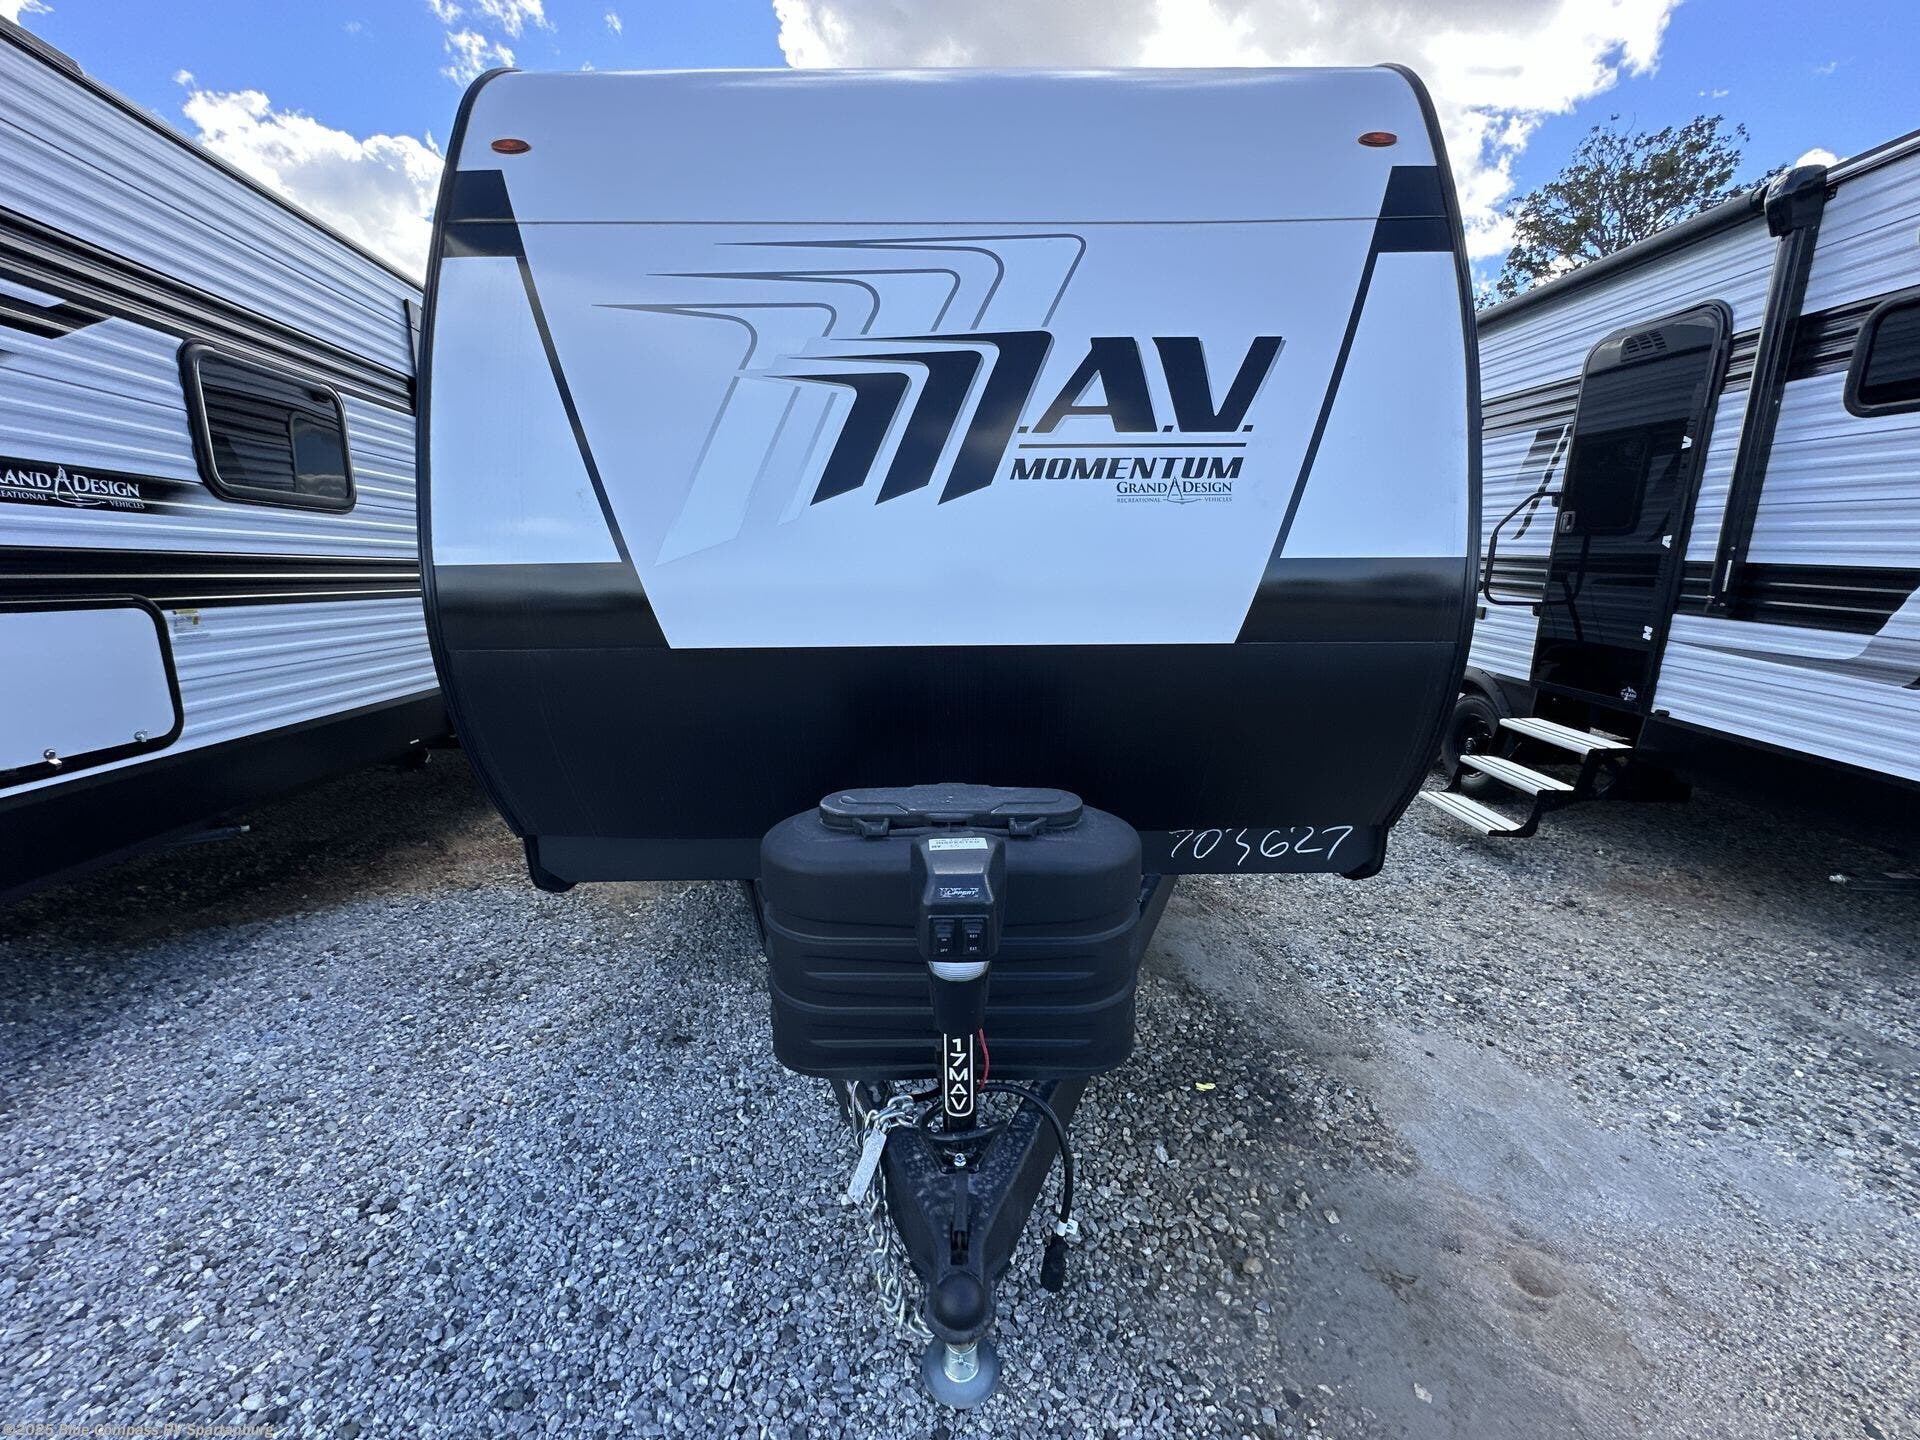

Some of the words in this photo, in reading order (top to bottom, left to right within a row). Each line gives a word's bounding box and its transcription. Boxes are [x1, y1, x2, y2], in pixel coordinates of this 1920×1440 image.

[1010, 457, 1244, 480] MOMENTUM
[0, 469, 52, 488] AND
[73, 474, 140, 497] DESIGN
[1116, 481, 1167, 494] GRAND
[1182, 481, 1232, 493] DESIGN
[0, 490, 48, 501] EATIONAL
[109, 499, 146, 510] VEHICLES
[948, 1038, 969, 1110] 17MAV
